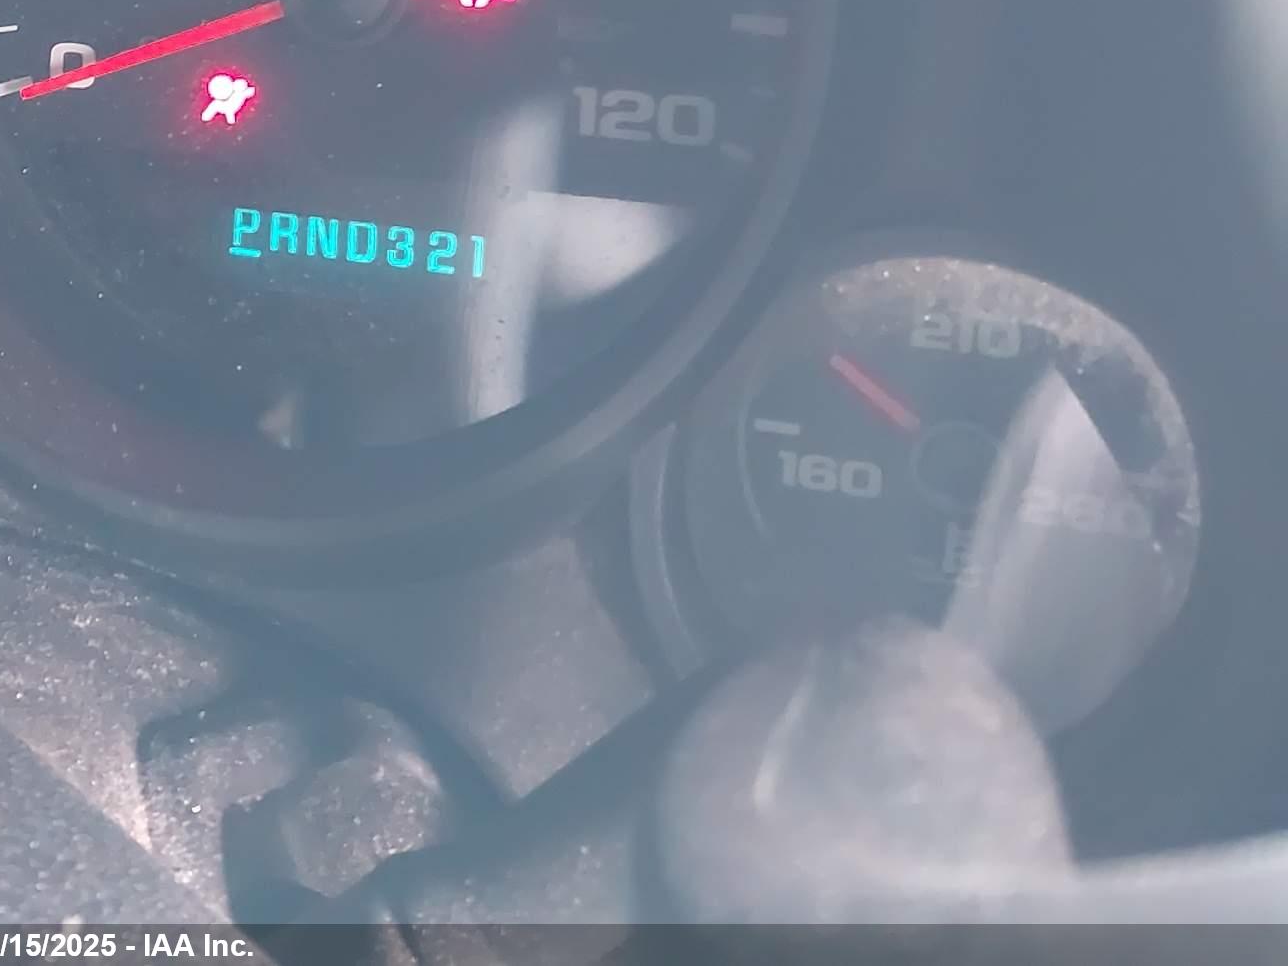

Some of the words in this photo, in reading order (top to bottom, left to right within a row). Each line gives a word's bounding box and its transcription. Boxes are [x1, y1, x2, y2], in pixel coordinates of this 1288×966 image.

[48, 41, 97, 90] 0
[572, 85, 717, 147] 120
[910, 311, 1022, 359] 210
[777, 449, 883, 499] 160
